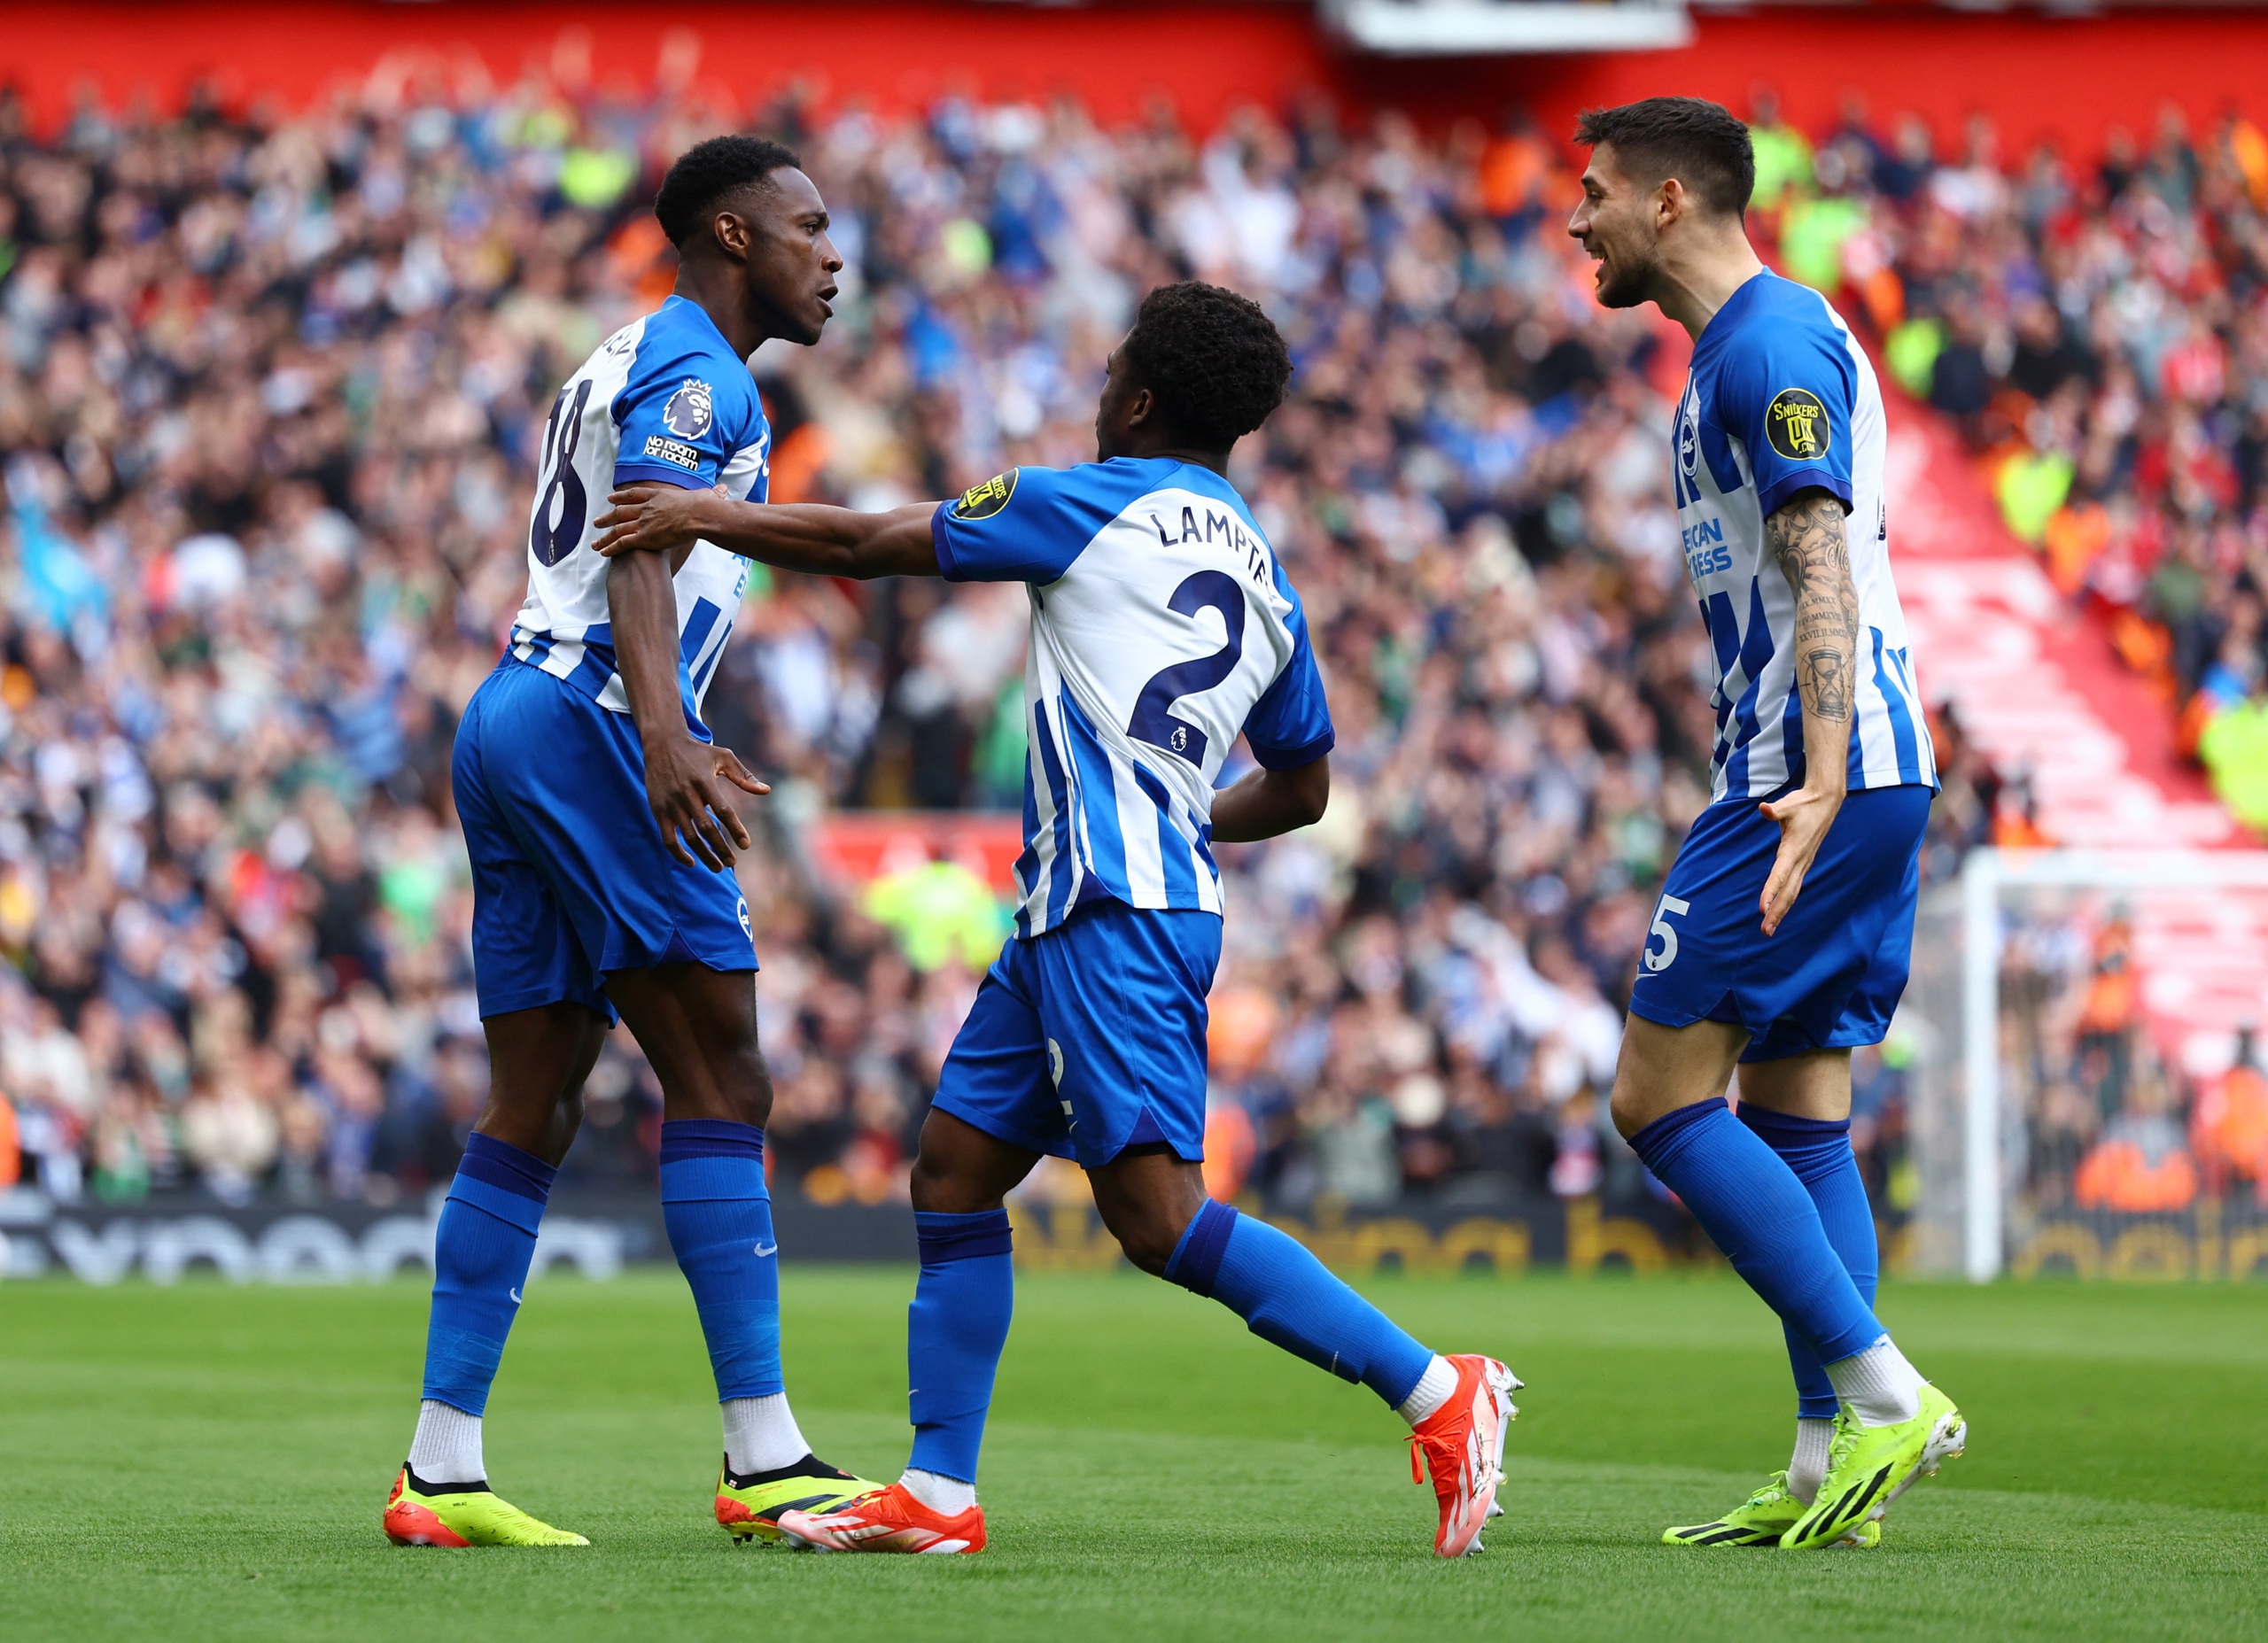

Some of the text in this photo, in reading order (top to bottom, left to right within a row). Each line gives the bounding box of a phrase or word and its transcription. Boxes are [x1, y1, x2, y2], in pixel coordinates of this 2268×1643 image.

[532, 379, 593, 567] 18
[646, 435, 697, 460] No room
[660, 449, 698, 471] racism
[1126, 569, 1246, 771] 2
[1644, 893, 1690, 972] 5
